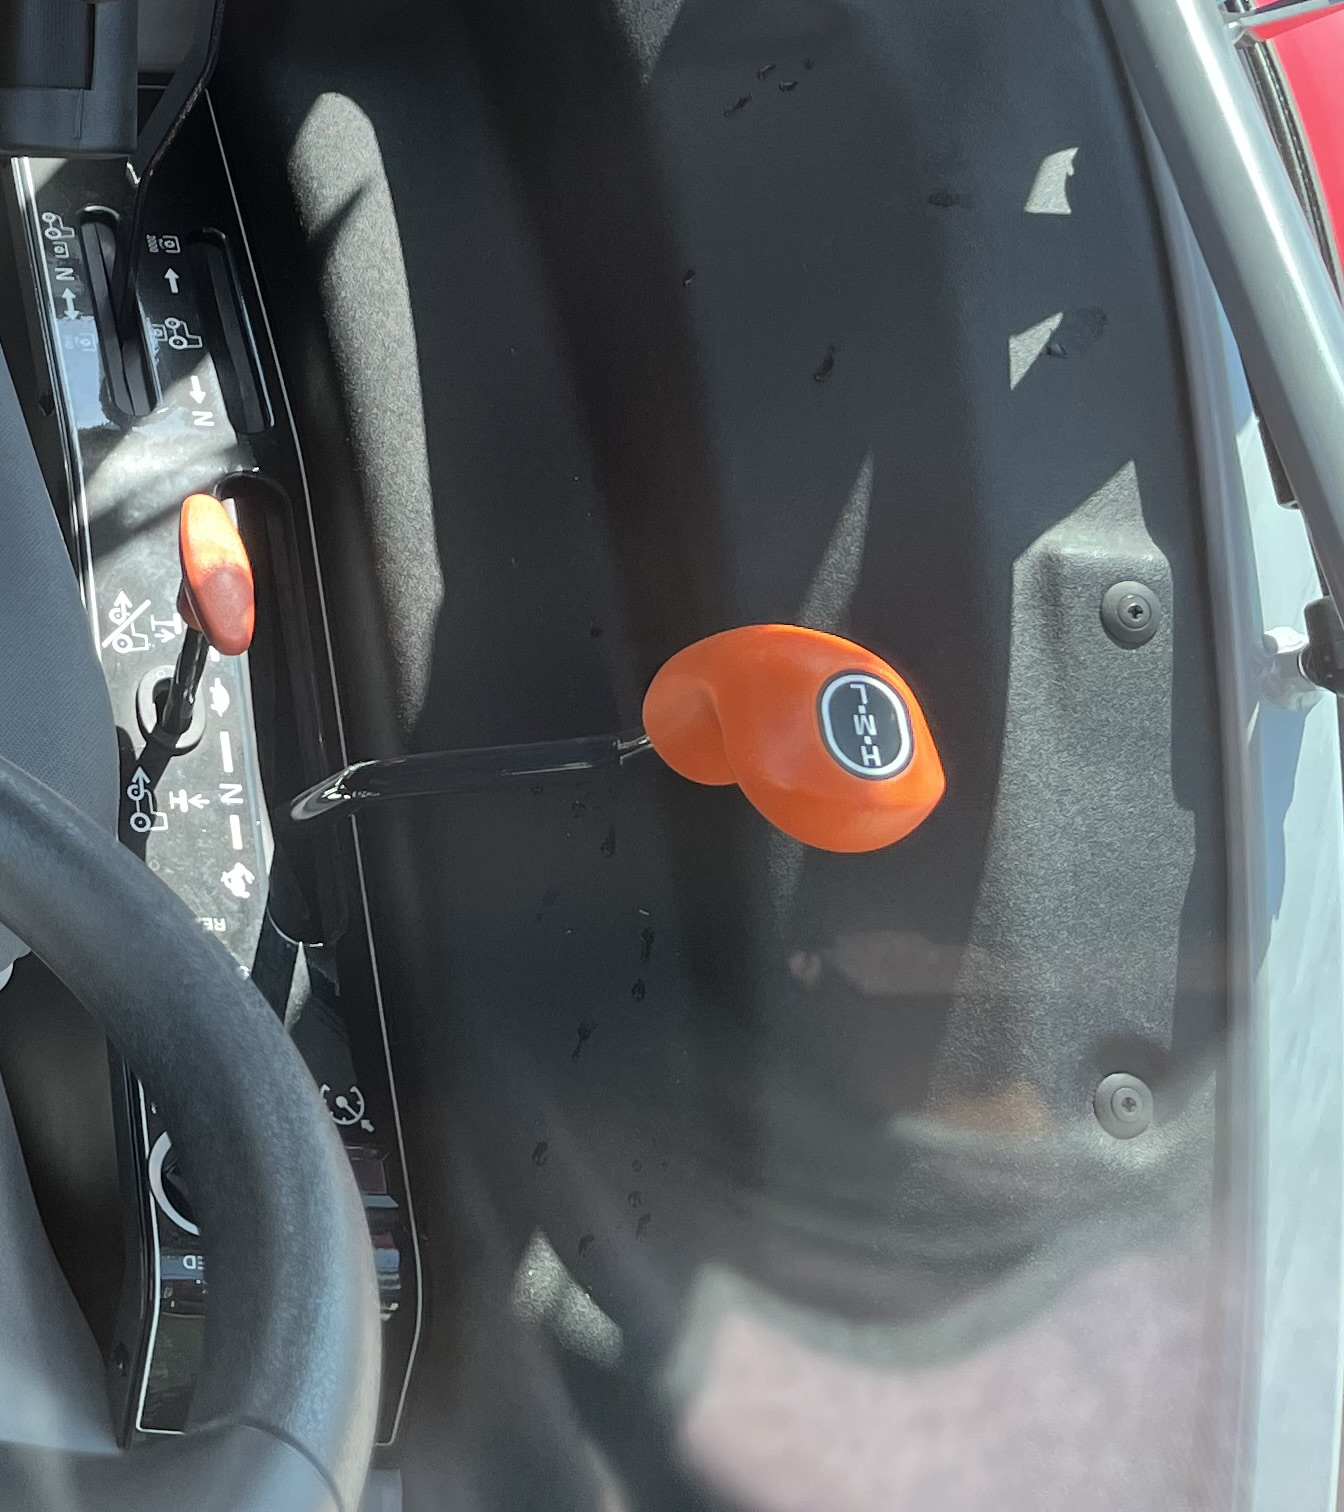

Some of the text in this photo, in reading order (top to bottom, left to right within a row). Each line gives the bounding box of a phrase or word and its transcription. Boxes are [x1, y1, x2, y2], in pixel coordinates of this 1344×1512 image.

[55, 267, 75, 281] N
[192, 411, 214, 426] N
[849, 683, 868, 704] L
[861, 745, 882, 766] H
[219, 783, 244, 805] N
